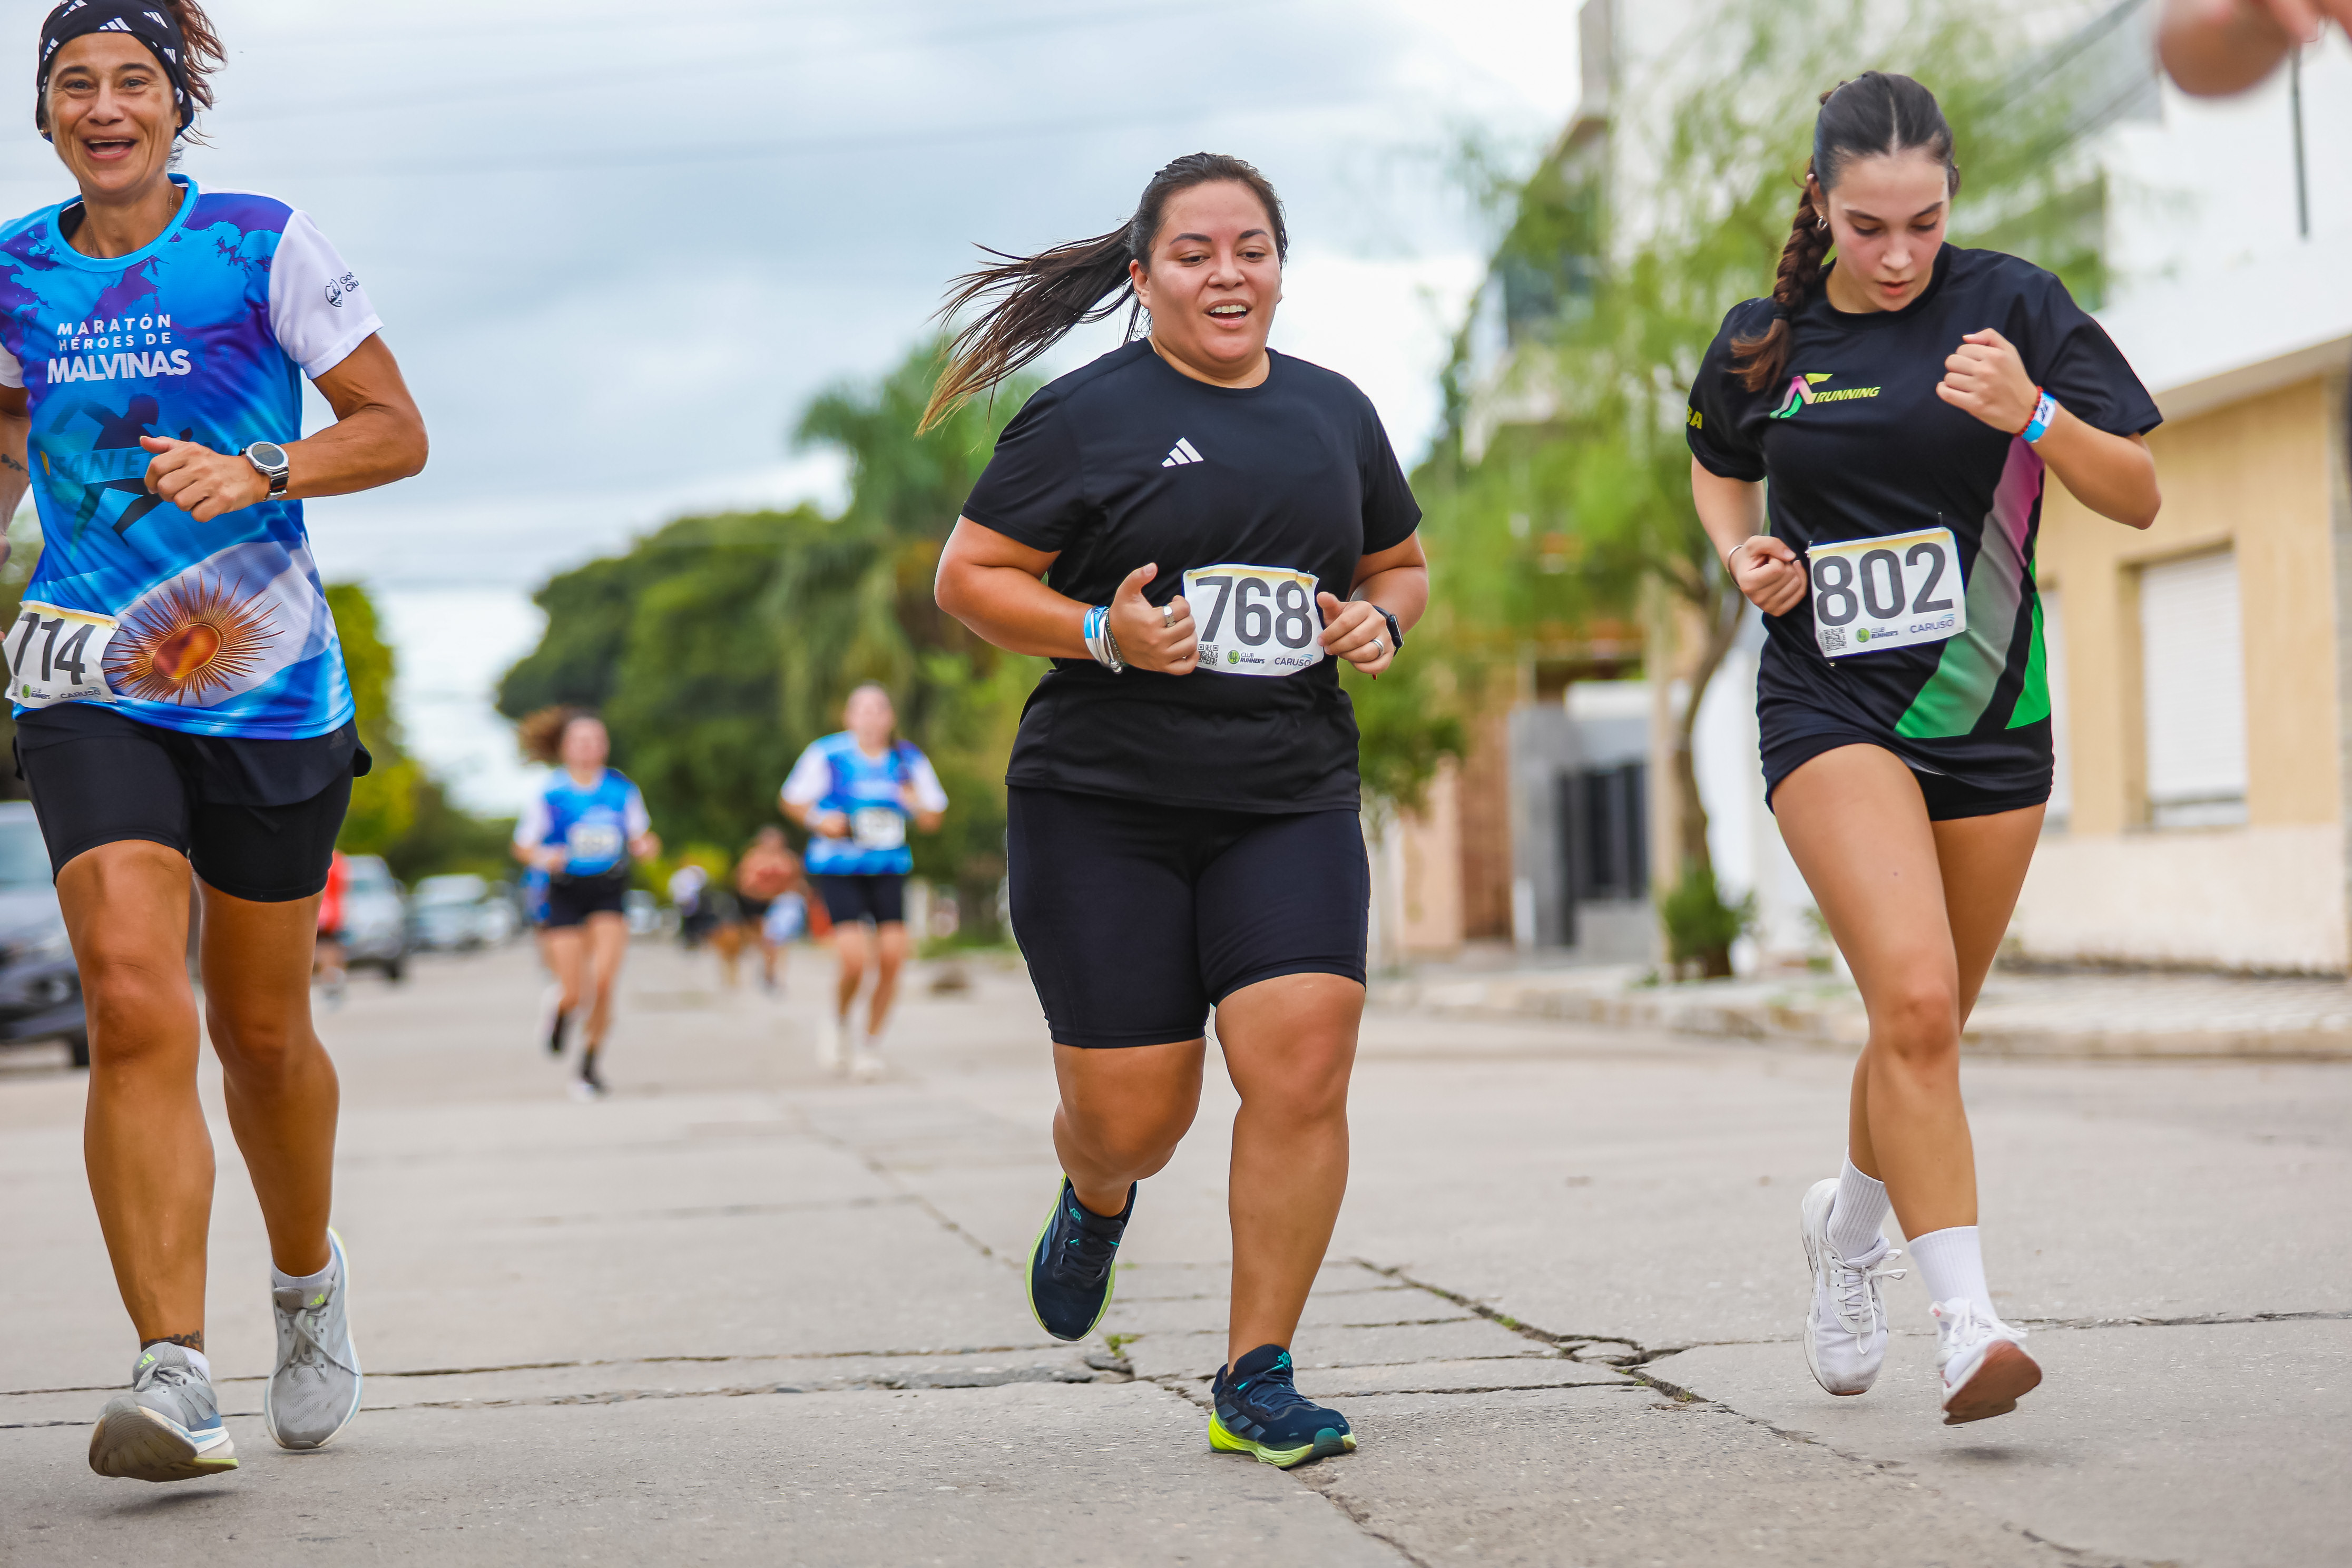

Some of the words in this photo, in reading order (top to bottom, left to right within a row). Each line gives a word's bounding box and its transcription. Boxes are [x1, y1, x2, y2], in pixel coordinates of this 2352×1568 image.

[57, 313, 171, 335] MARATÓN
[58, 335, 134, 351] HÉROES
[145, 332, 171, 345] DE
[47, 349, 191, 384] MALVINAS
[1816, 386, 1881, 403] RUNNING
[1813, 542, 1954, 626] 802
[1195, 576, 1312, 649] 768
[1910, 619, 1954, 633] CARUSO
[14, 612, 97, 685] 714
[1275, 657, 1311, 667] CARUSO
[60, 690, 101, 699] CARUSO
